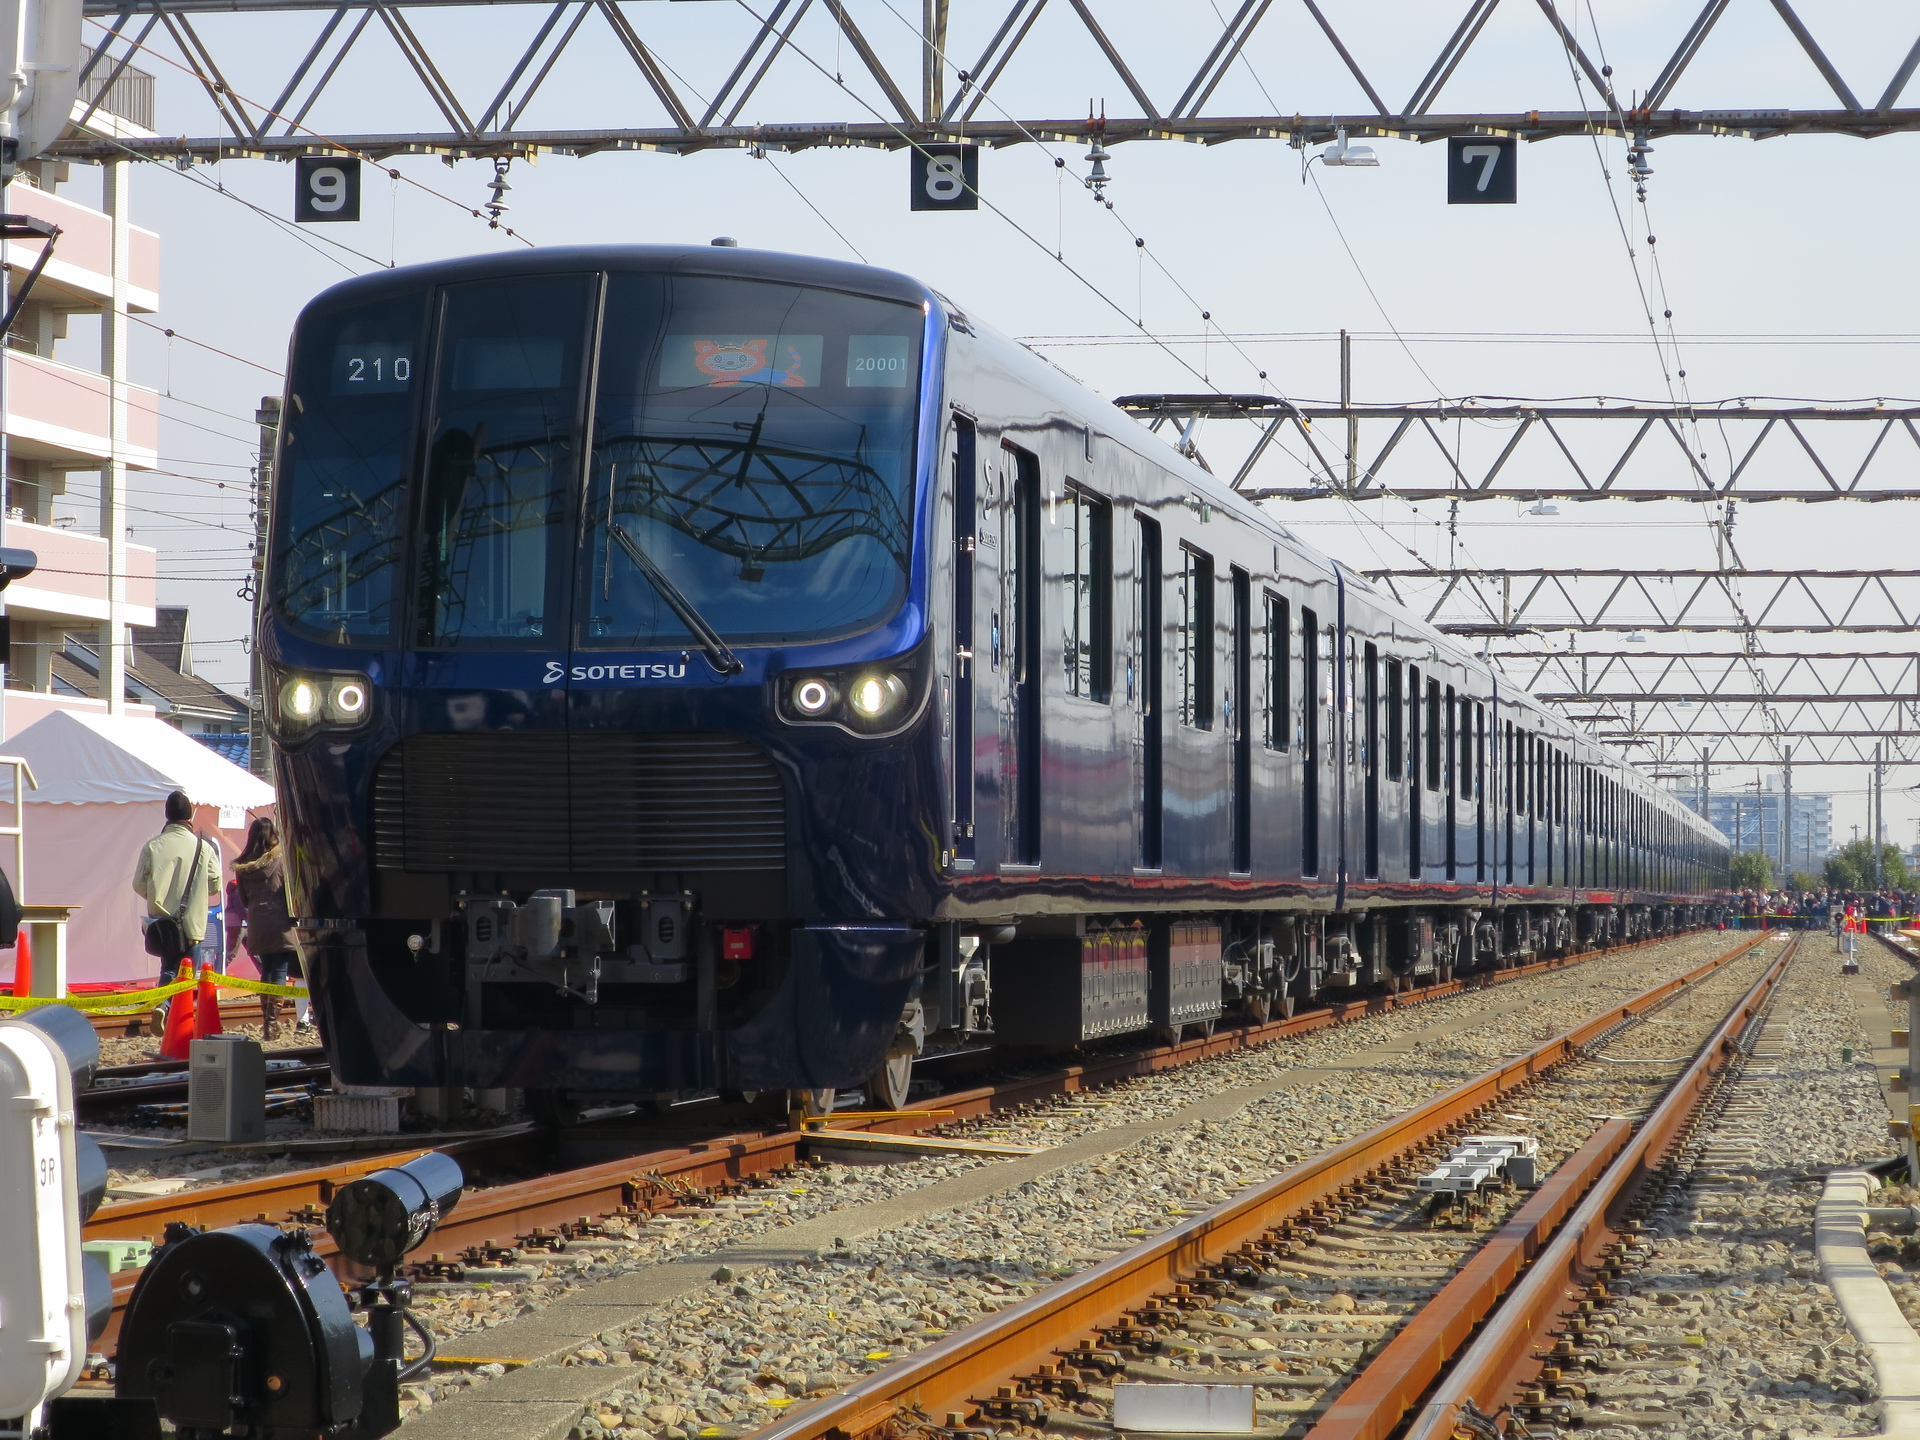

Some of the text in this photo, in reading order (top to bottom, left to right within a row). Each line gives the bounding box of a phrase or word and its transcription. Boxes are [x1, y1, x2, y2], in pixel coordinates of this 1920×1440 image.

[925, 154, 963, 201] 8
[1463, 145, 1501, 192] 7
[310, 166, 346, 212] 9
[348, 357, 410, 381] 210
[855, 357, 906, 371] 20001
[571, 664, 686, 681] SOTETSU
[40, 1157, 55, 1187] 9R
